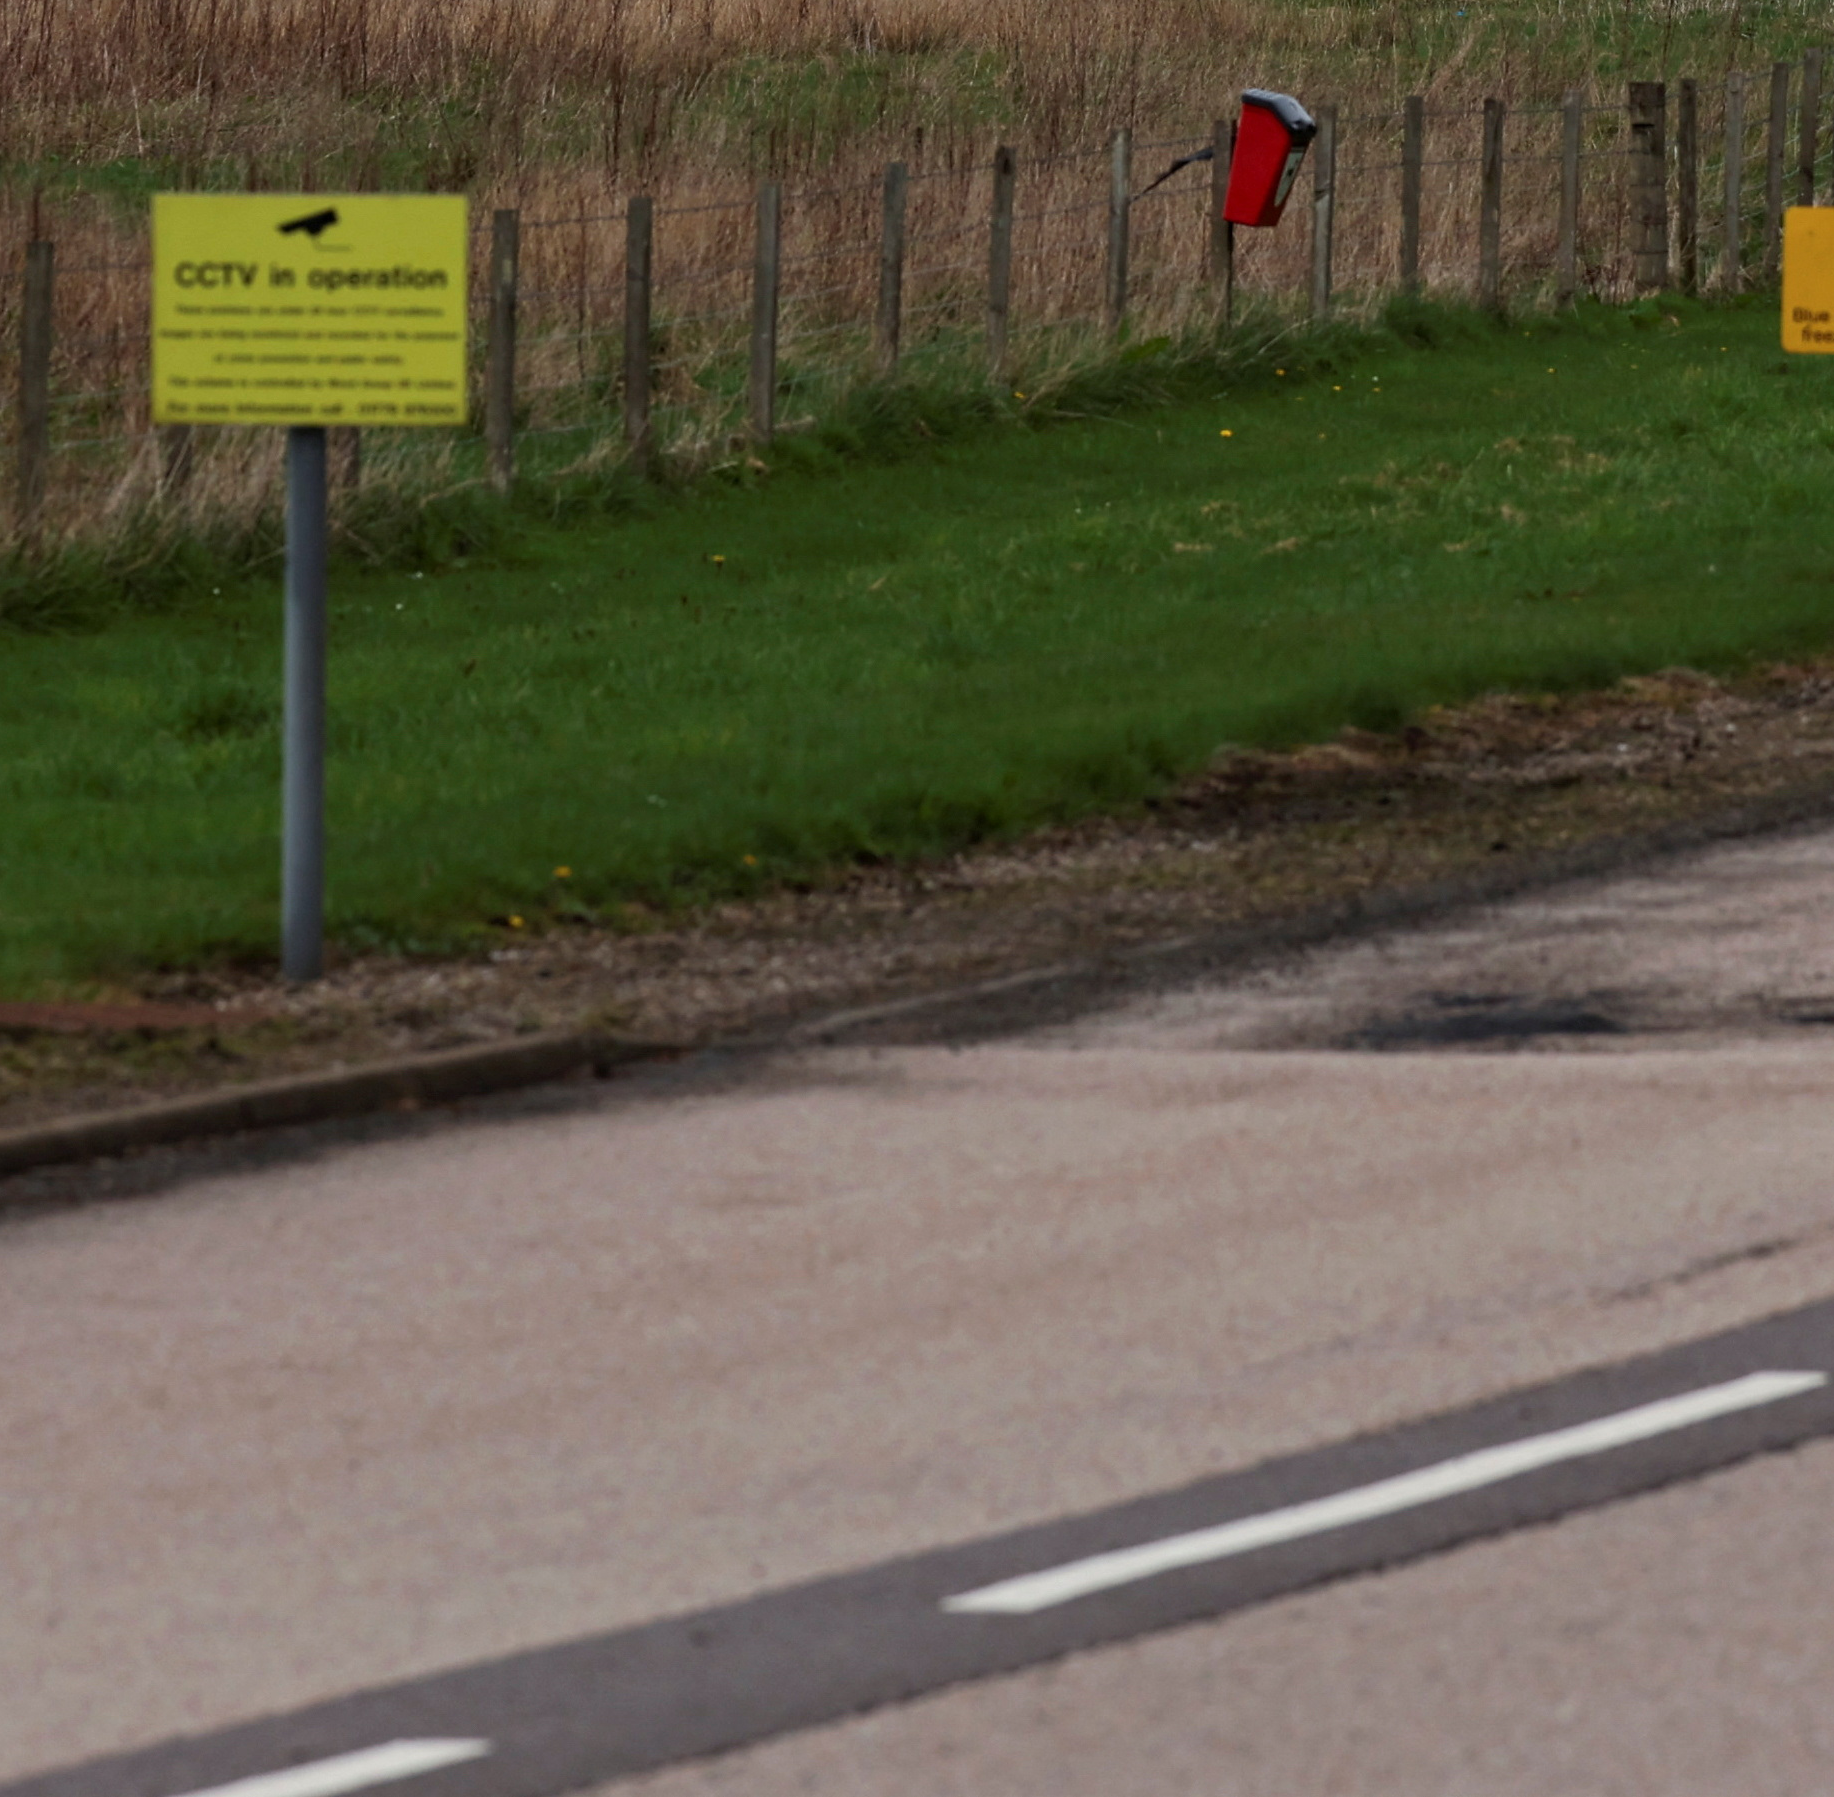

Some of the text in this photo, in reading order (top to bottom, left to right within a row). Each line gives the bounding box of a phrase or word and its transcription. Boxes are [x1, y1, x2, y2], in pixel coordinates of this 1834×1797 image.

[173, 261, 449, 293] CCTV in operation
[1792, 307, 1830, 323] Blue
